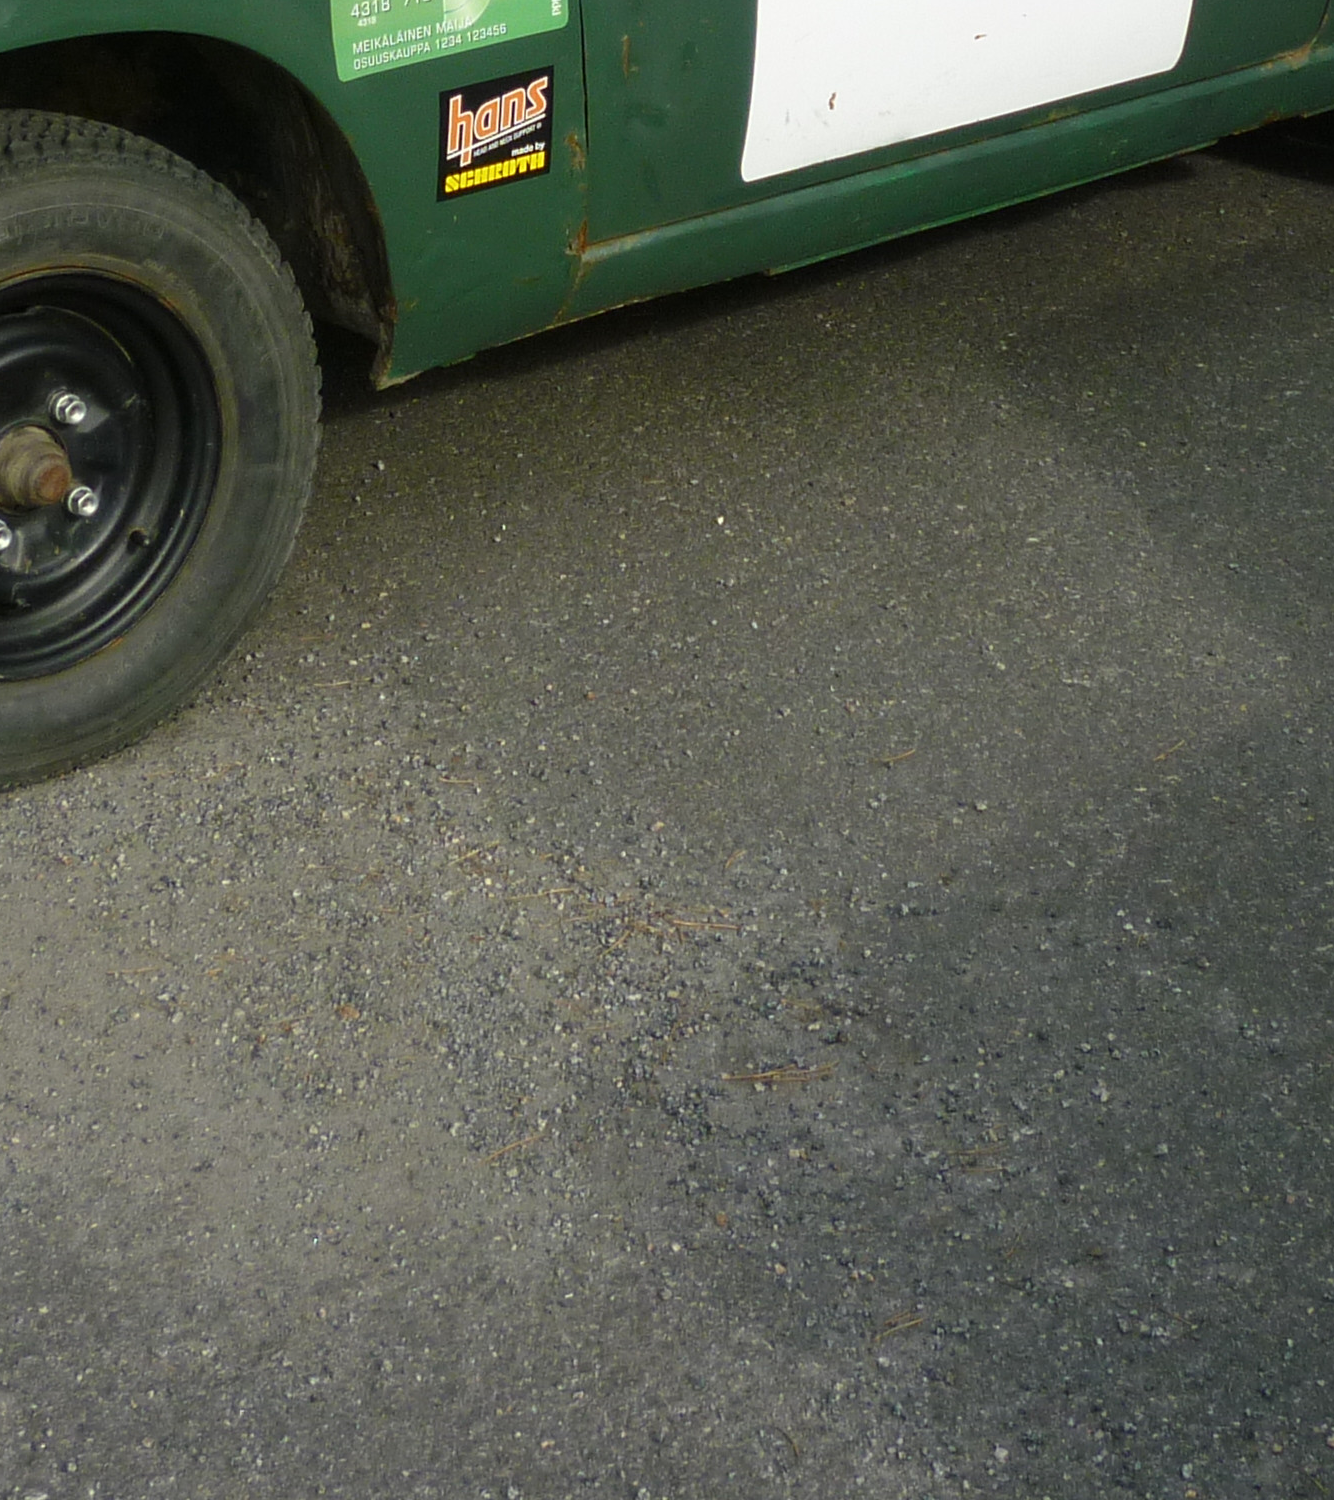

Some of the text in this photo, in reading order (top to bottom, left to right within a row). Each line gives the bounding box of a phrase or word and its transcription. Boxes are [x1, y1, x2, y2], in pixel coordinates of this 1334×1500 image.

[353, 23, 507, 71] OSUUSKAUPPA 1234 123456
[435, 16, 475, 35] MAIJA
[447, 76, 548, 167] hans
[445, 151, 545, 193] SCHROTH
